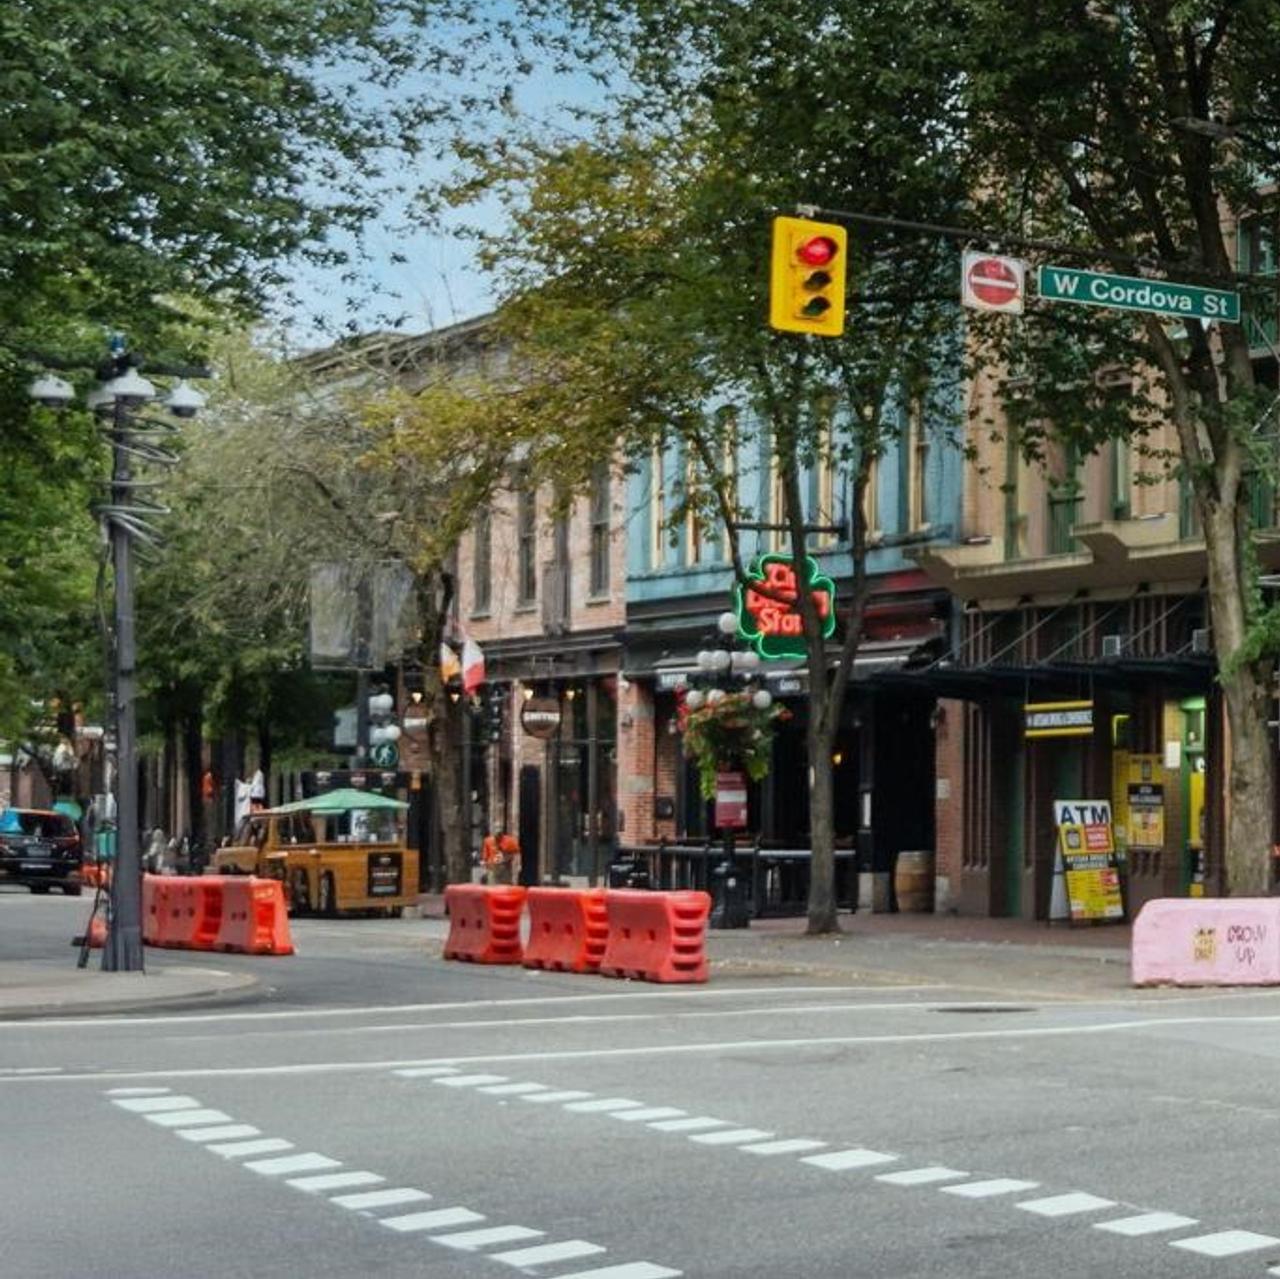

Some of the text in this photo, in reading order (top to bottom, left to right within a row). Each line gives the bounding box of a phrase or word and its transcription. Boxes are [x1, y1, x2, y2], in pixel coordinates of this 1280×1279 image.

[1053, 272, 1228, 316] W Cordova St
[1061, 805, 1110, 825] ATM
